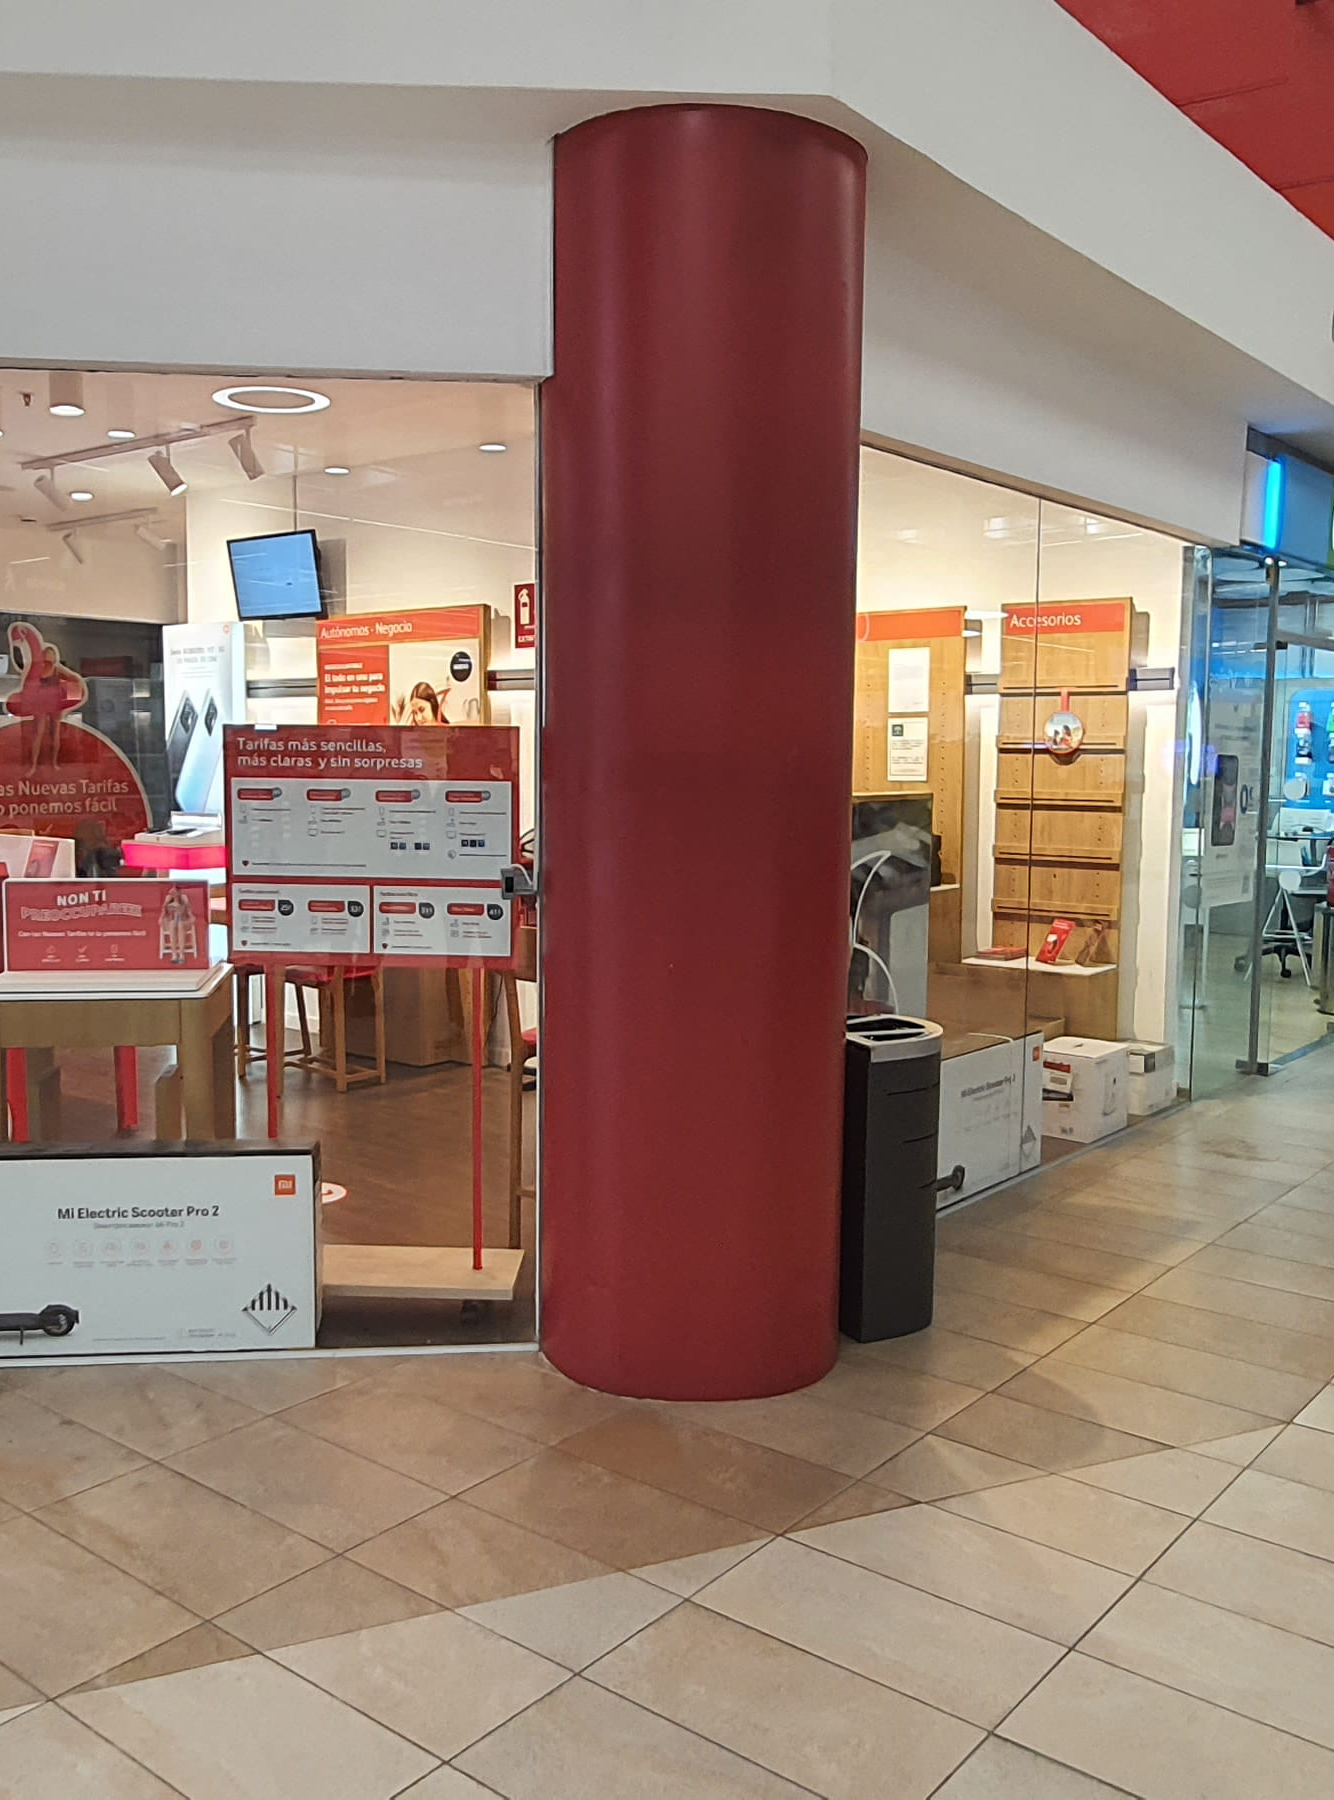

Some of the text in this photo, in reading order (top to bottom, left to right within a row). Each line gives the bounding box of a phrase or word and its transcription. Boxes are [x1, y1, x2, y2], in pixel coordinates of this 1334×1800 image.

[1009, 612, 1082, 629] Accesorios
[320, 621, 413, 639] Autónomos Negocio
[237, 737, 387, 753] Tarifas más sencillas,
[237, 754, 423, 770] más claras y sin sorpresas
[18, 780, 76, 796] Nuevas
[80, 779, 129, 794] Tarifas
[9, 801, 83, 818] ponemos
[85, 798, 117, 812] fácil
[57, 890, 107, 906] NON TI
[57, 1205, 220, 1219] Mi Electric Scooter Pro 2
